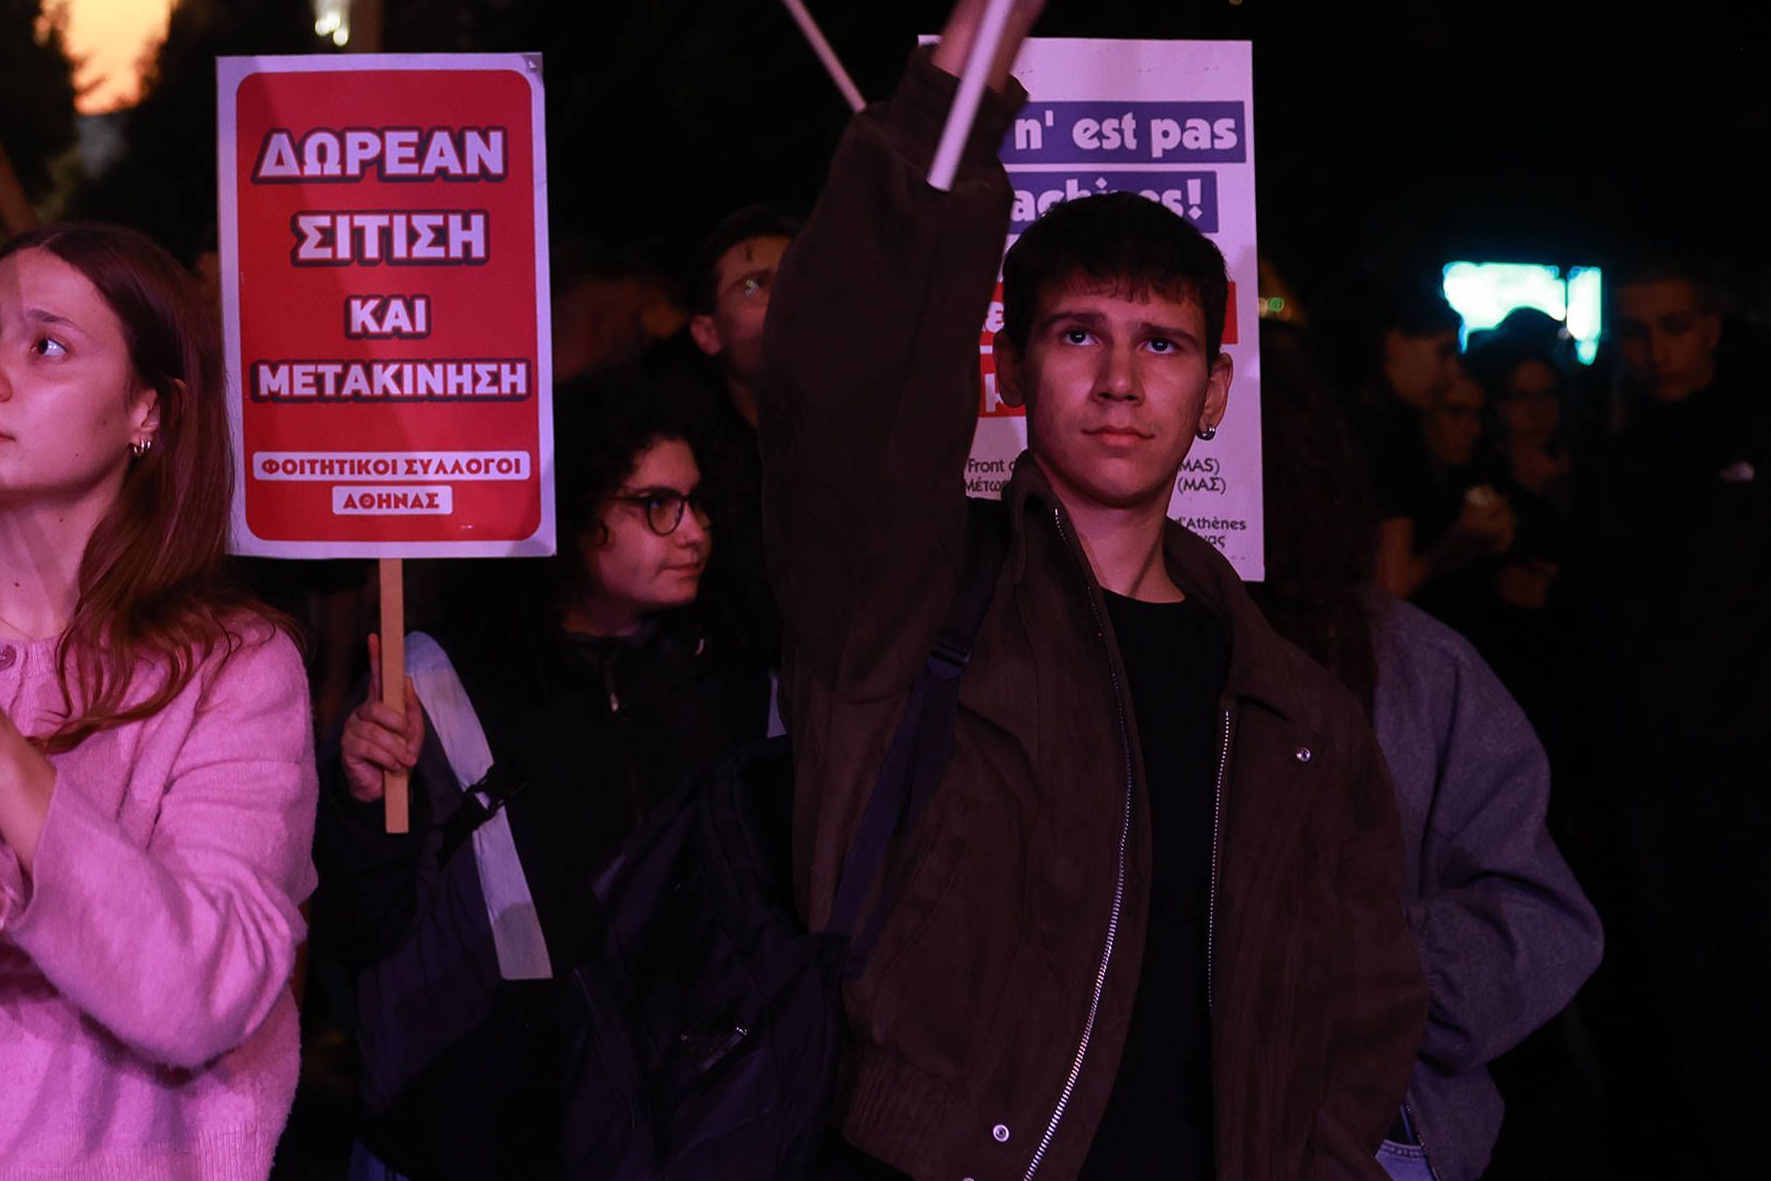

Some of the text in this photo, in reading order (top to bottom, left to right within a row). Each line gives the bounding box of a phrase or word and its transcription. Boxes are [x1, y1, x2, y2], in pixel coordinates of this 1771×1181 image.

[1072, 111, 1137, 150] est
[1150, 117, 1238, 158] pas
[257, 130, 505, 178] ΔΩΡΕΑΝ
[297, 214, 486, 260] ΣΙΤΙΣΗ
[349, 297, 427, 335] ΚΑΙ
[257, 363, 528, 397] ΜΕΤΑΚΙΝΗΣΗ
[260, 457, 521, 477] ΦΟΙΤΗΤΙΚΟΙ ΣΥΛΛΟΓΟΙ
[968, 458, 1005, 474] Front
[1178, 457, 1220, 476] MAS)
[342, 491, 440, 510] ΑΘΗΝΑΣ
[1177, 477, 1226, 495] (ΜΑΣ)
